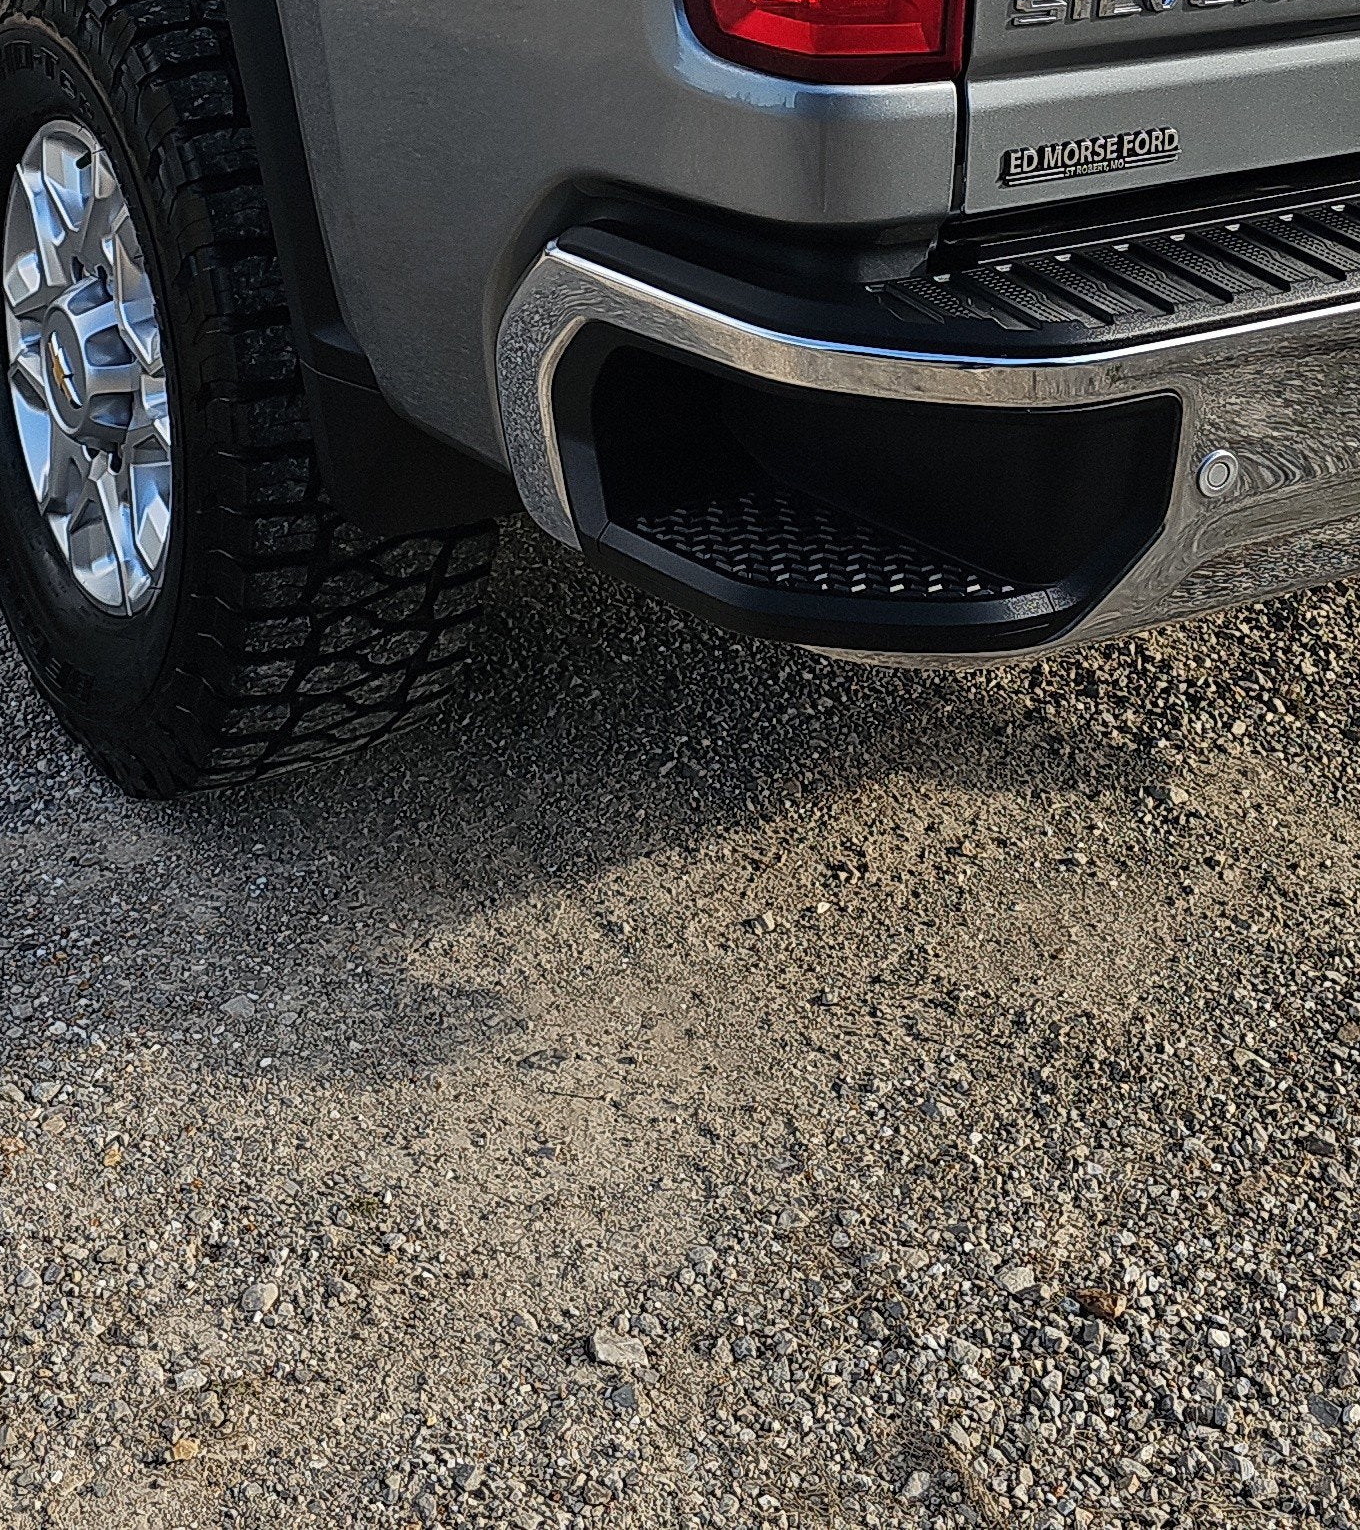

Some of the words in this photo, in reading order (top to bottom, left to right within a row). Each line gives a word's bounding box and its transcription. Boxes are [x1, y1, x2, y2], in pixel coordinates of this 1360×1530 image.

[1009, 149, 1038, 173] ED
[1043, 138, 1118, 169] MORSE
[1122, 128, 1179, 158] FORD
[1110, 159, 1126, 170] MO
